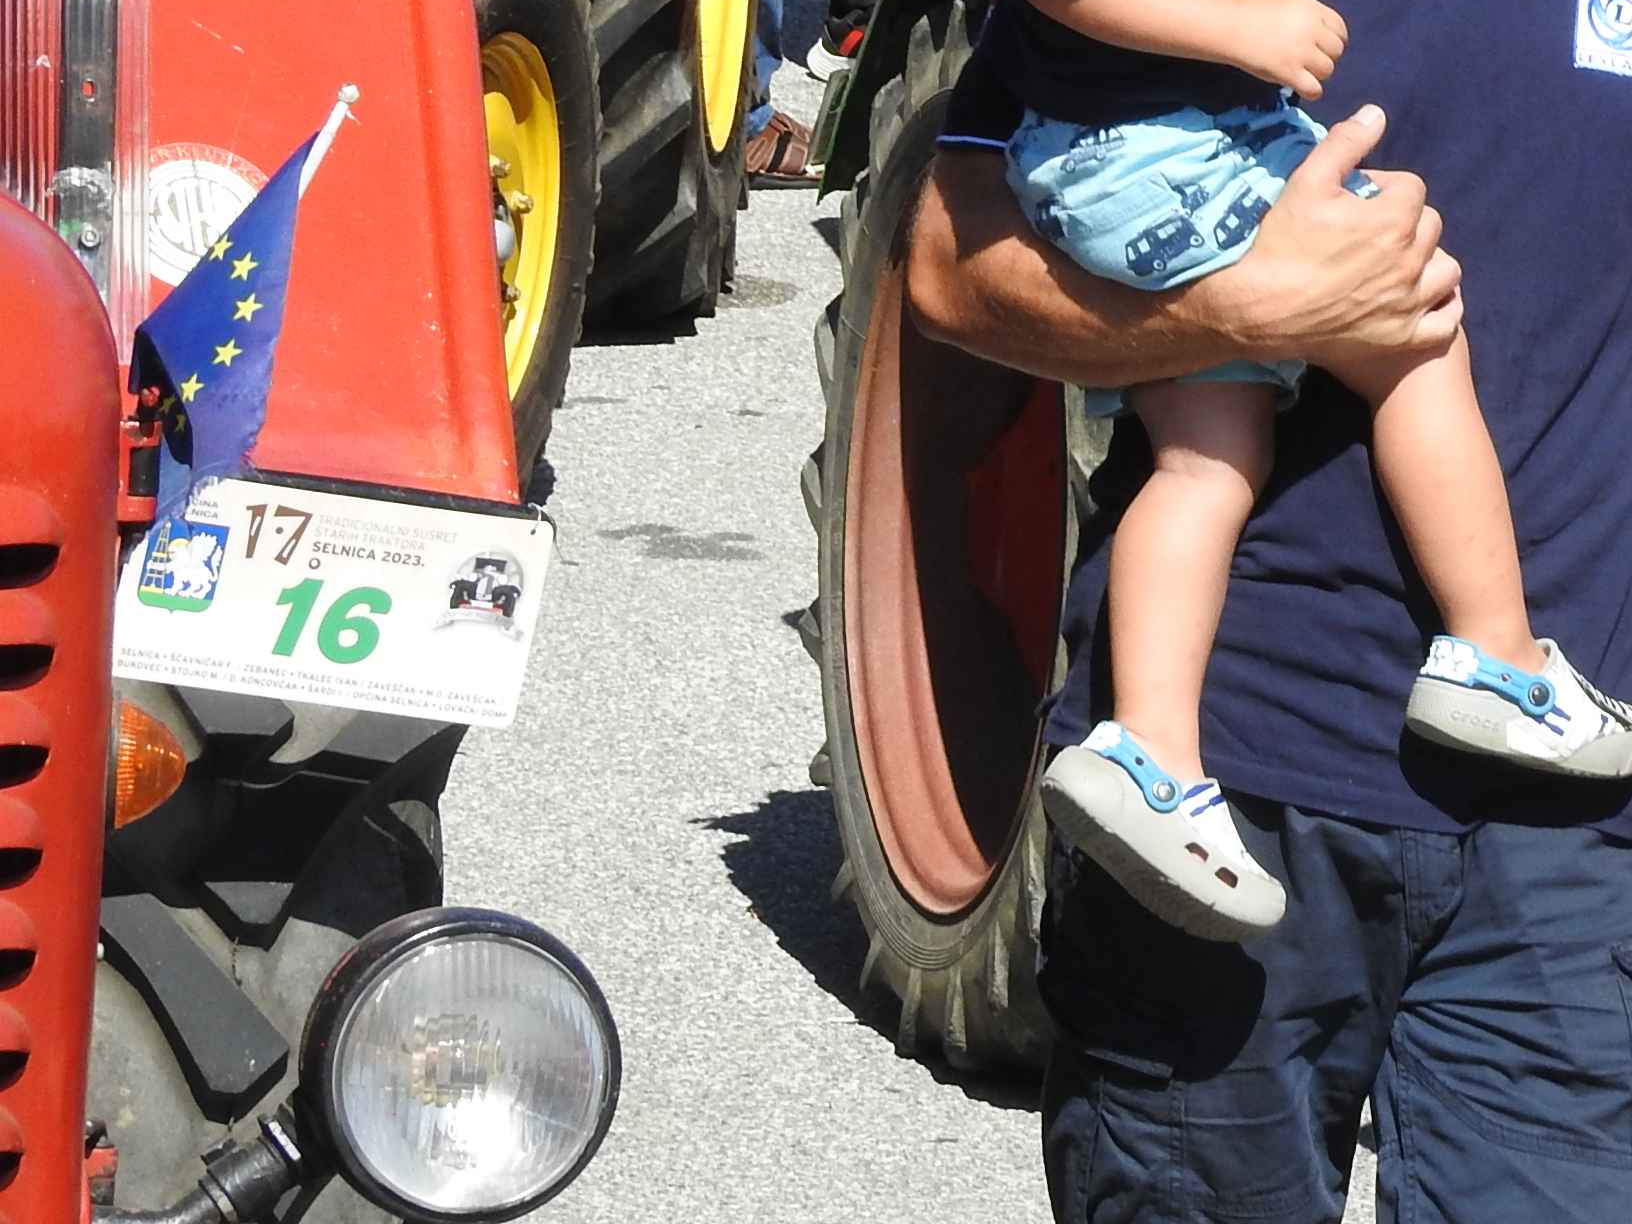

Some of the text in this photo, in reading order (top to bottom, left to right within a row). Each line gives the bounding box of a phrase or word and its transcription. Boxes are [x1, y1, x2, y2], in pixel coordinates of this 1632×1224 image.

[313, 527, 426, 551] STARIH TRAKTORA
[318, 513, 459, 545] TRADICIONALNI SUSRET
[312, 541, 425, 568] SELNICA 2023.
[271, 577, 393, 665] 16
[121, 647, 159, 659] SELNICA
